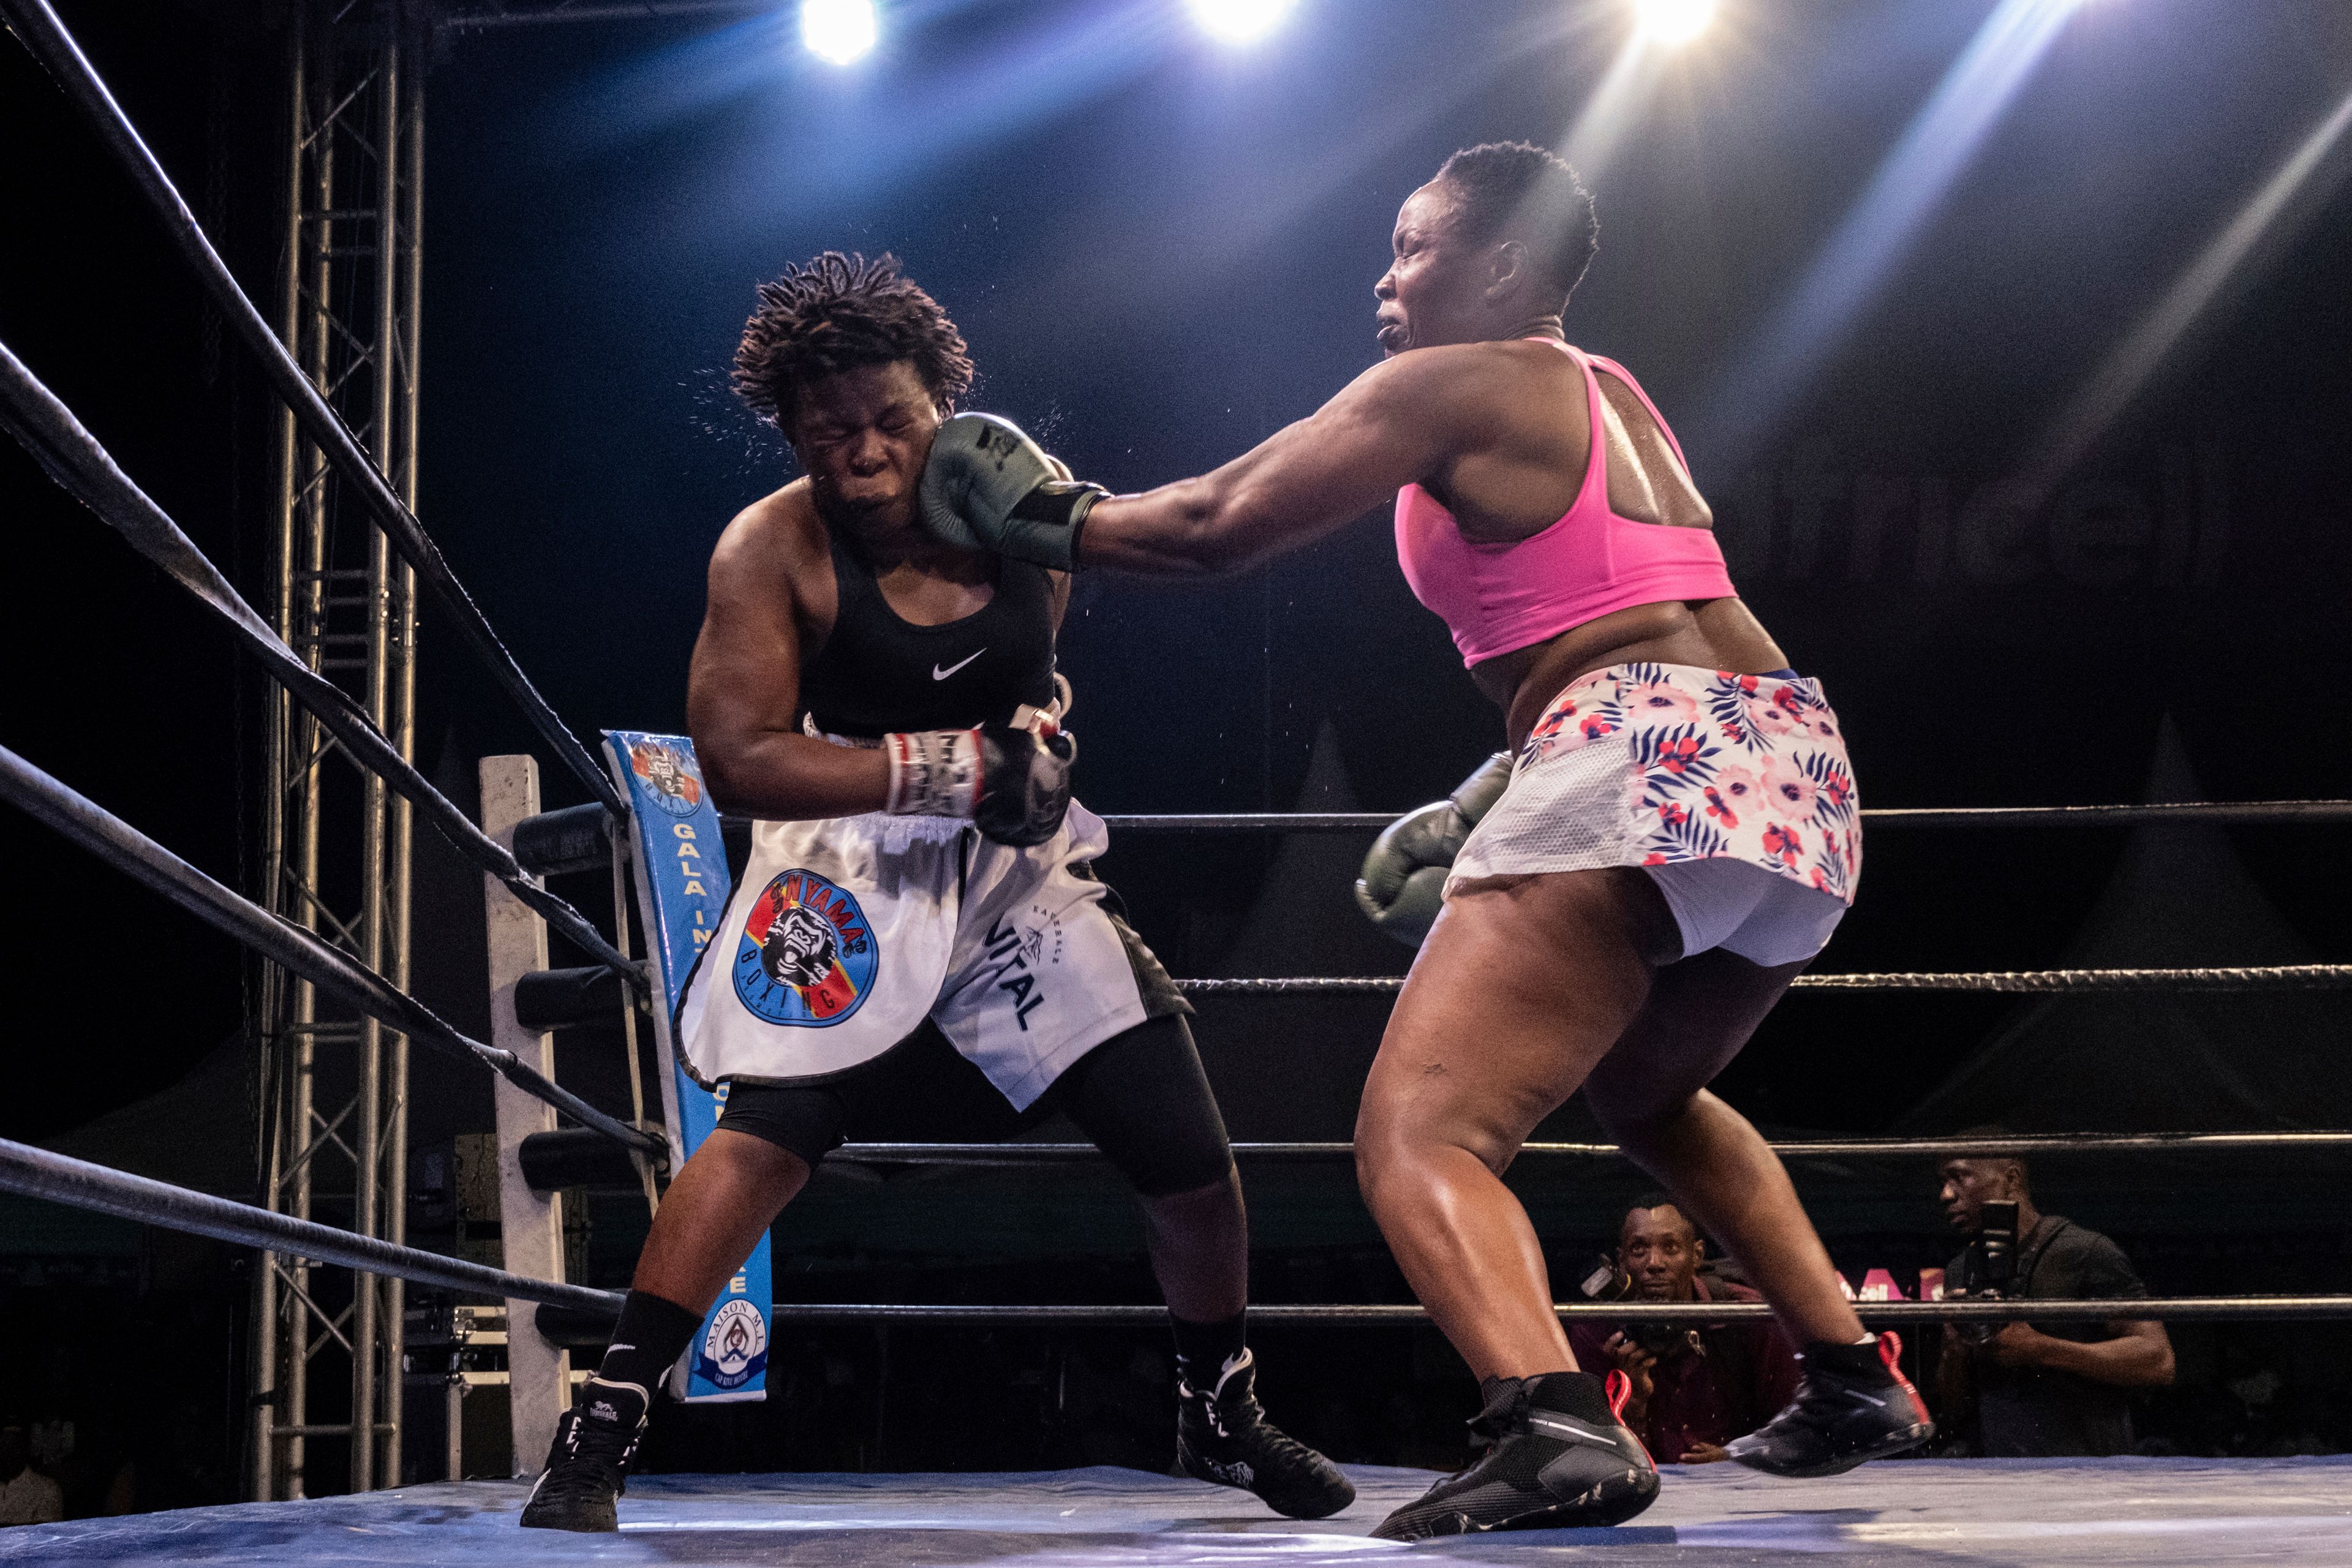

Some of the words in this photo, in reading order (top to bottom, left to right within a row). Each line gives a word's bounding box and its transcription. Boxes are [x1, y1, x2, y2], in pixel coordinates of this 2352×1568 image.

[674, 824, 707, 896] GALA
[741, 949, 835, 1012] BOXING
[984, 918, 1045, 1031] VITAL
[707, 1302, 748, 1348] MAISON
